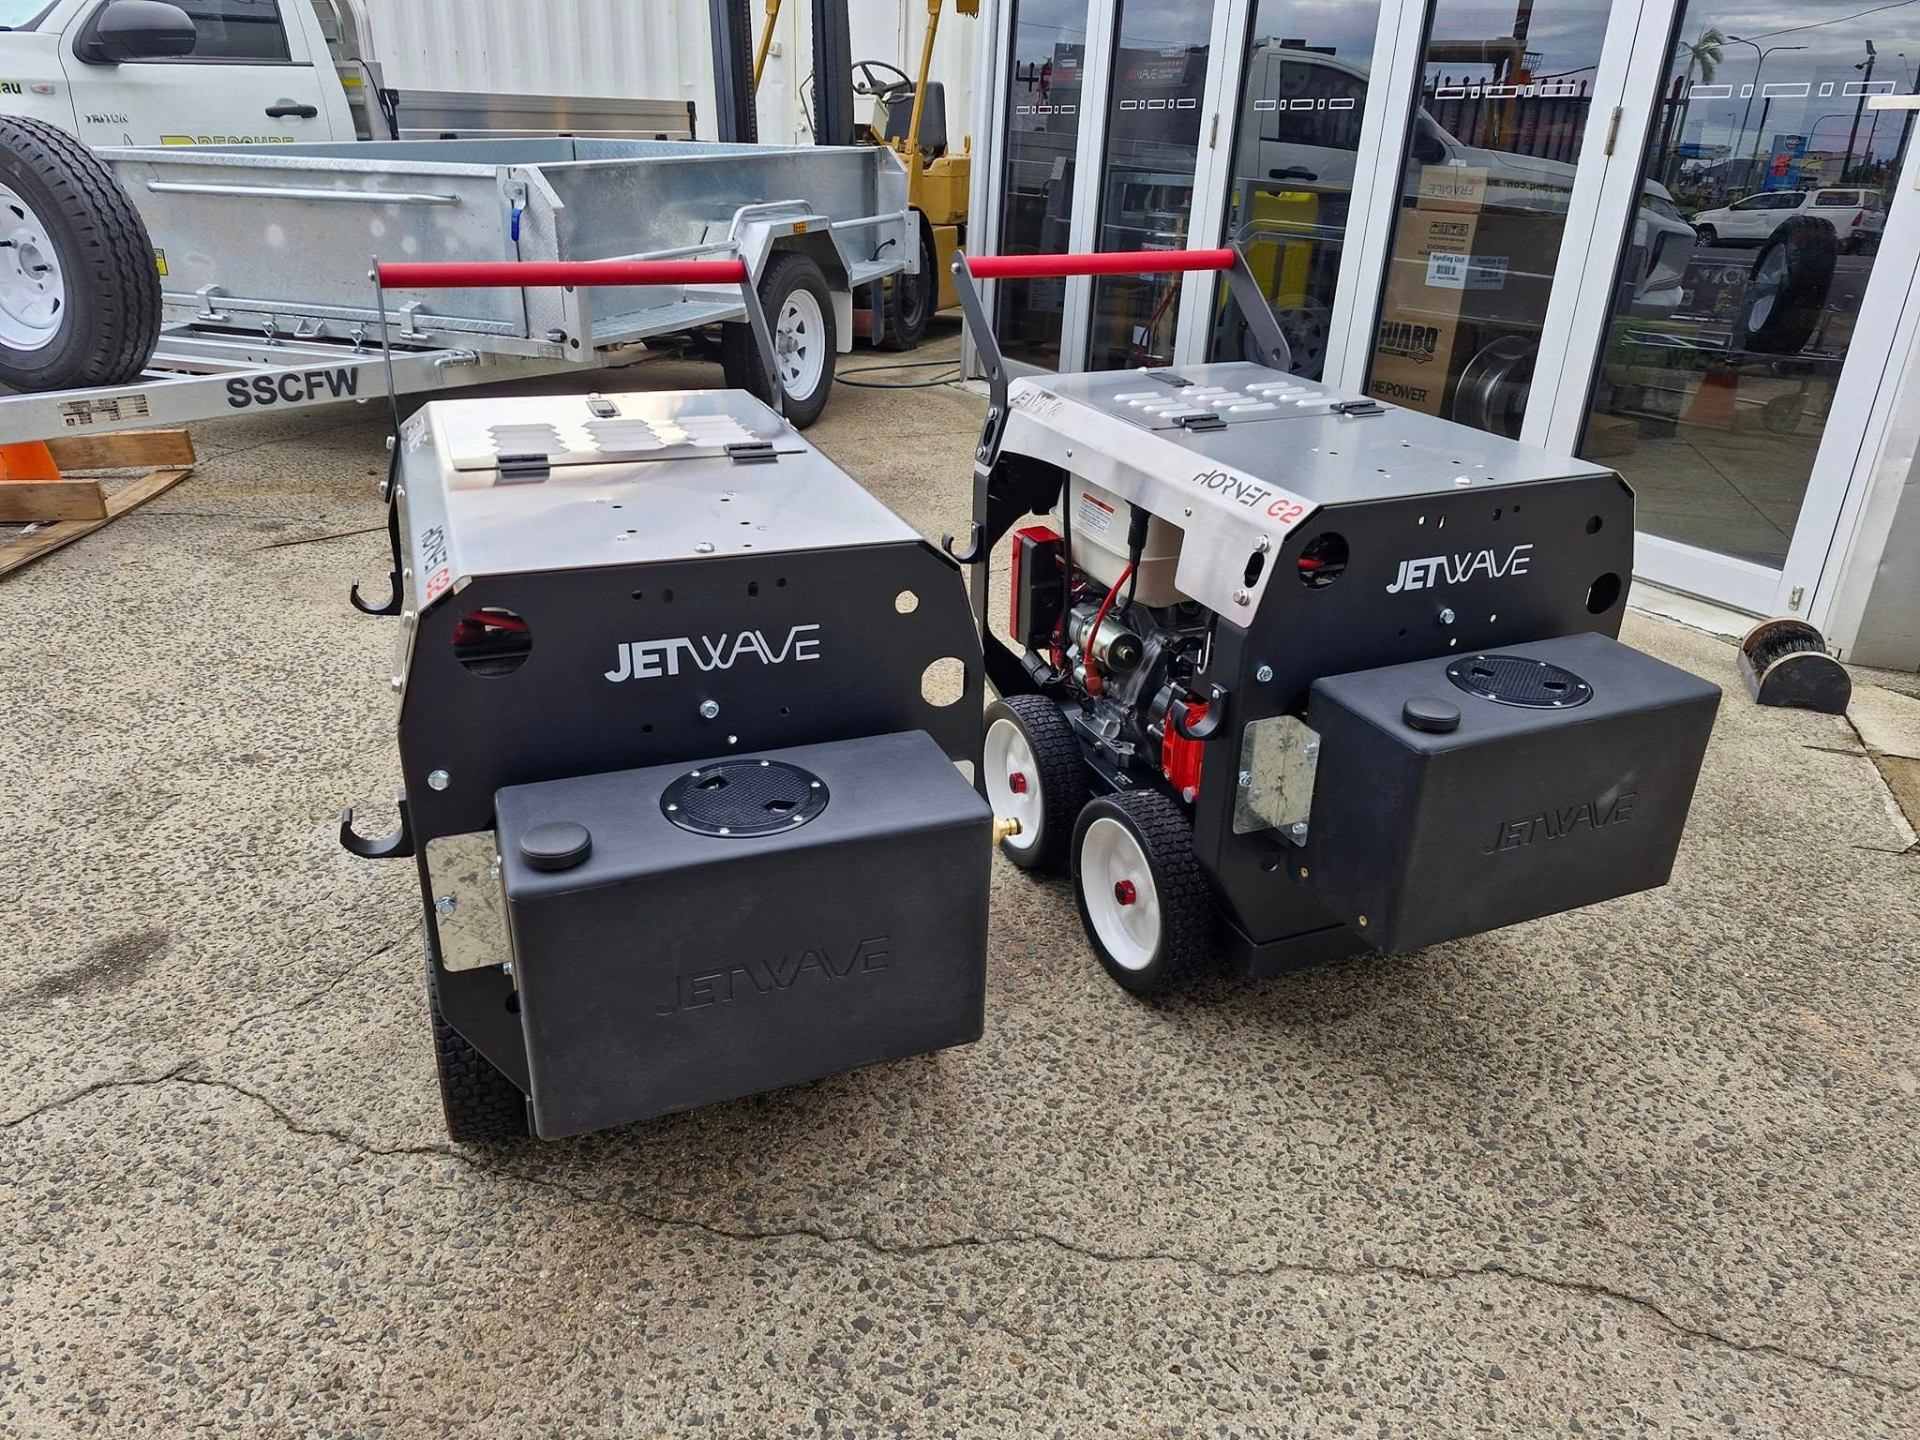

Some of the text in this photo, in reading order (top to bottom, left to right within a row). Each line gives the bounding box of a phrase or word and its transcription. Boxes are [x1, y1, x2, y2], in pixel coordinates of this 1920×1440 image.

[84, 113, 129, 124] TRITON
[1429, 183, 1474, 196] FRAGILE
[226, 367, 359, 408] SSCFW
[1192, 469, 1304, 524] HORNET G2
[1386, 543, 1533, 594] JETWAVE
[604, 623, 820, 683] JETWAVE
[1484, 791, 1638, 856] JETWAVE
[656, 935, 889, 1016] JETWAVE
